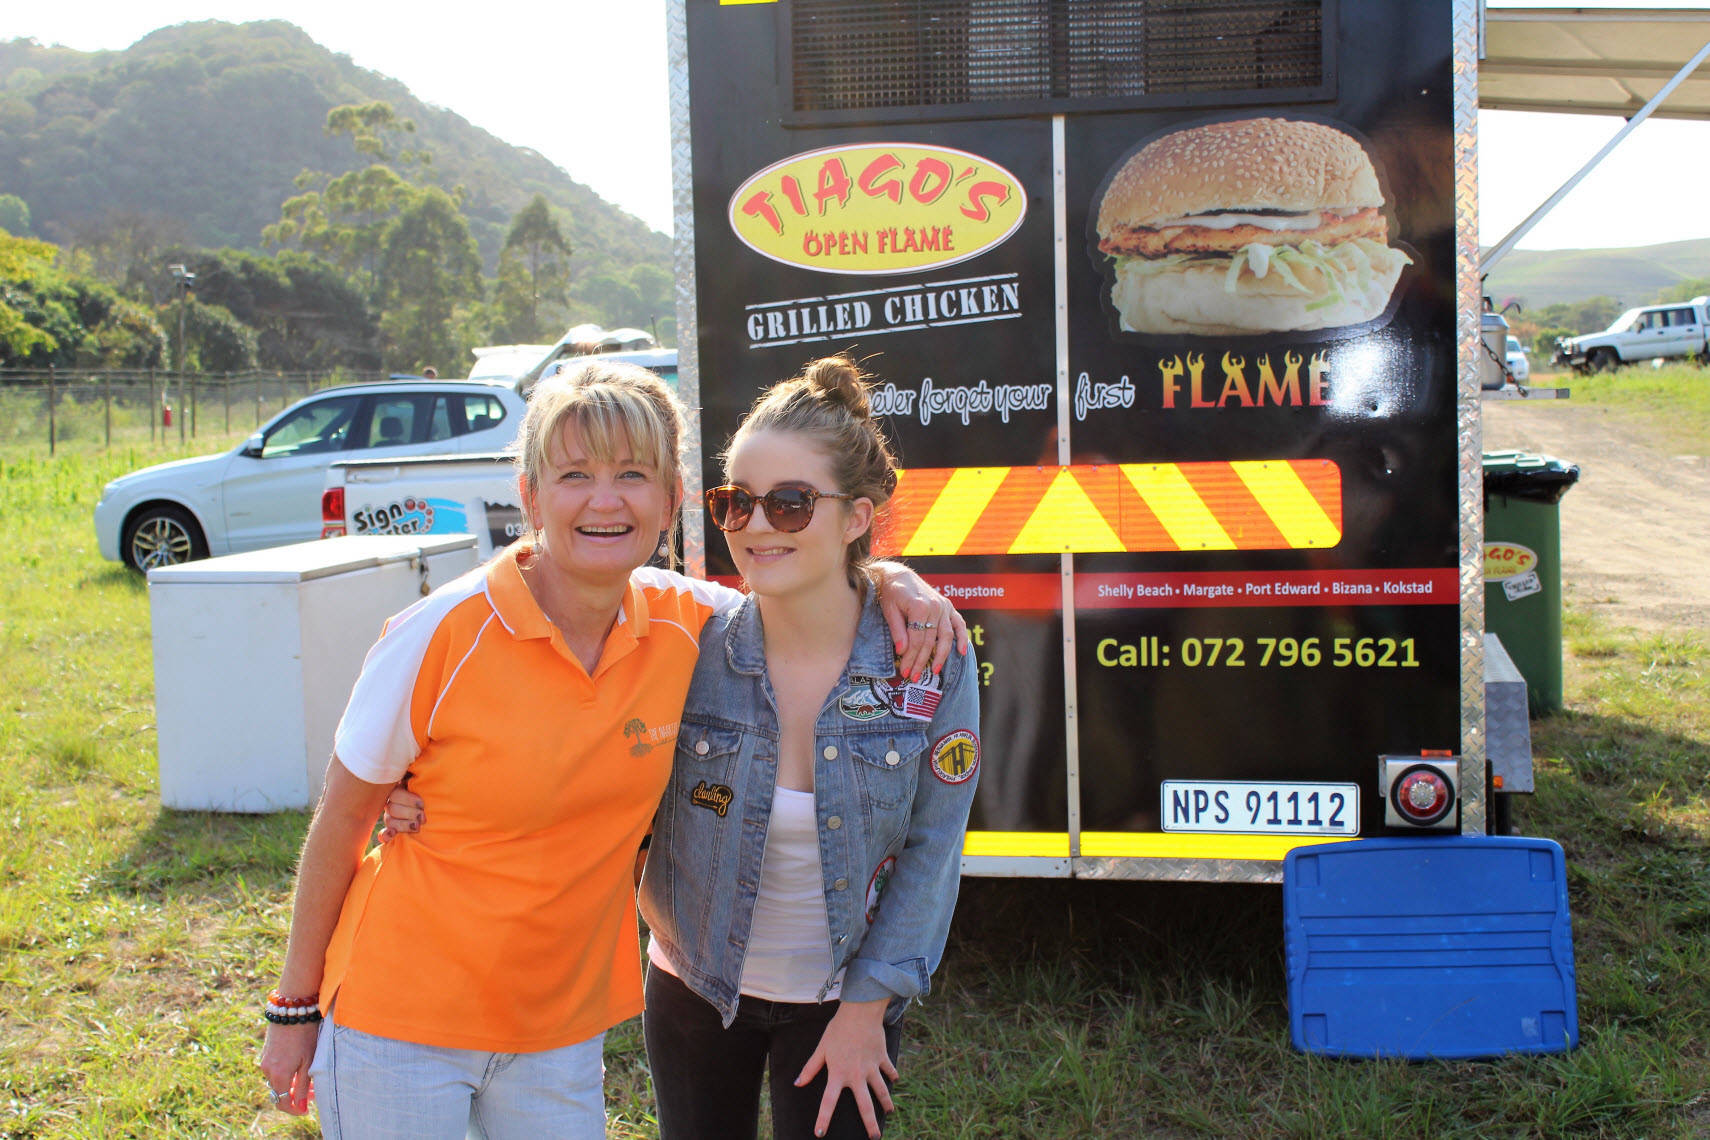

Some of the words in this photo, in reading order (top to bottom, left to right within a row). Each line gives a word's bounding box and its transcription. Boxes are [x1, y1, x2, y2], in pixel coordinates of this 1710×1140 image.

[741, 154, 1012, 236] TIAGO'S
[803, 229, 868, 256] OPEN
[878, 225, 955, 254] FLAME
[746, 300, 872, 342] GRILLED
[884, 282, 1021, 326] CHICKEN
[869, 383, 917, 416] ever
[919, 378, 993, 426] forget
[994, 384, 1053, 424] your
[1074, 372, 1136, 422] first
[353, 503, 403, 532] Sign
[943, 584, 1005, 600] Shepstone
[1097, 583, 1133, 599] Shelly
[1137, 584, 1173, 597] Beach
[1183, 583, 1234, 599] Margate
[1245, 583, 1271, 596] Port
[1274, 582, 1321, 595] Edward
[1332, 581, 1373, 595] Bizana
[1383, 580, 1433, 594] Kokstad
[1096, 636, 1171, 668] Call:
[1181, 637, 1246, 668] 072
[1256, 637, 1322, 668] 796
[1333, 637, 1420, 668] 5621
[693, 781, 732, 817] darling
[1172, 789, 1230, 825] NPS
[1245, 790, 1345, 828] 91112
